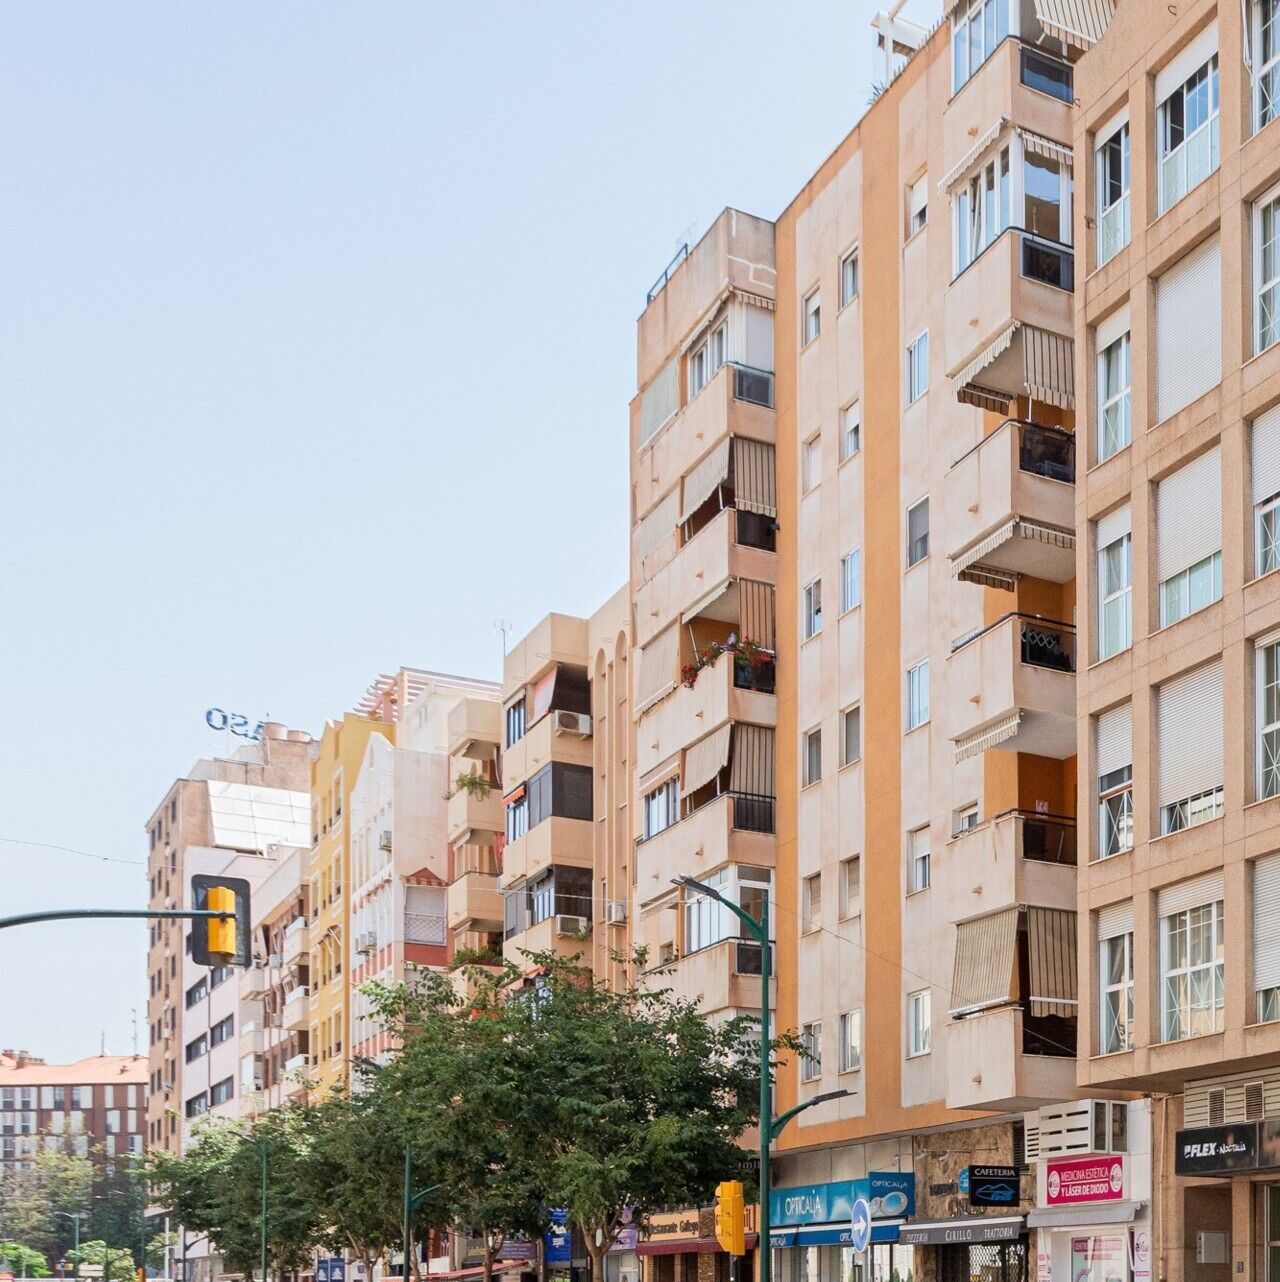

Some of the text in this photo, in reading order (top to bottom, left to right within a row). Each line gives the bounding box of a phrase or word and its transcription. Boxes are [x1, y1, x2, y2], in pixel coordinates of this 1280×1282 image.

[1191, 1143, 1215, 1157] FLEX
[974, 1168, 1016, 1176] CAFETERIA
[1061, 1166, 1108, 1181] MEDICINA ESTÉTICA
[1066, 1184, 1082, 1196] LÁSER
[1082, 1185, 1090, 1195] DE
[1090, 1183, 1109, 1194] DIODO
[945, 1229, 971, 1241] CIRILLO
[984, 1228, 1013, 1239] TRATTORIA
